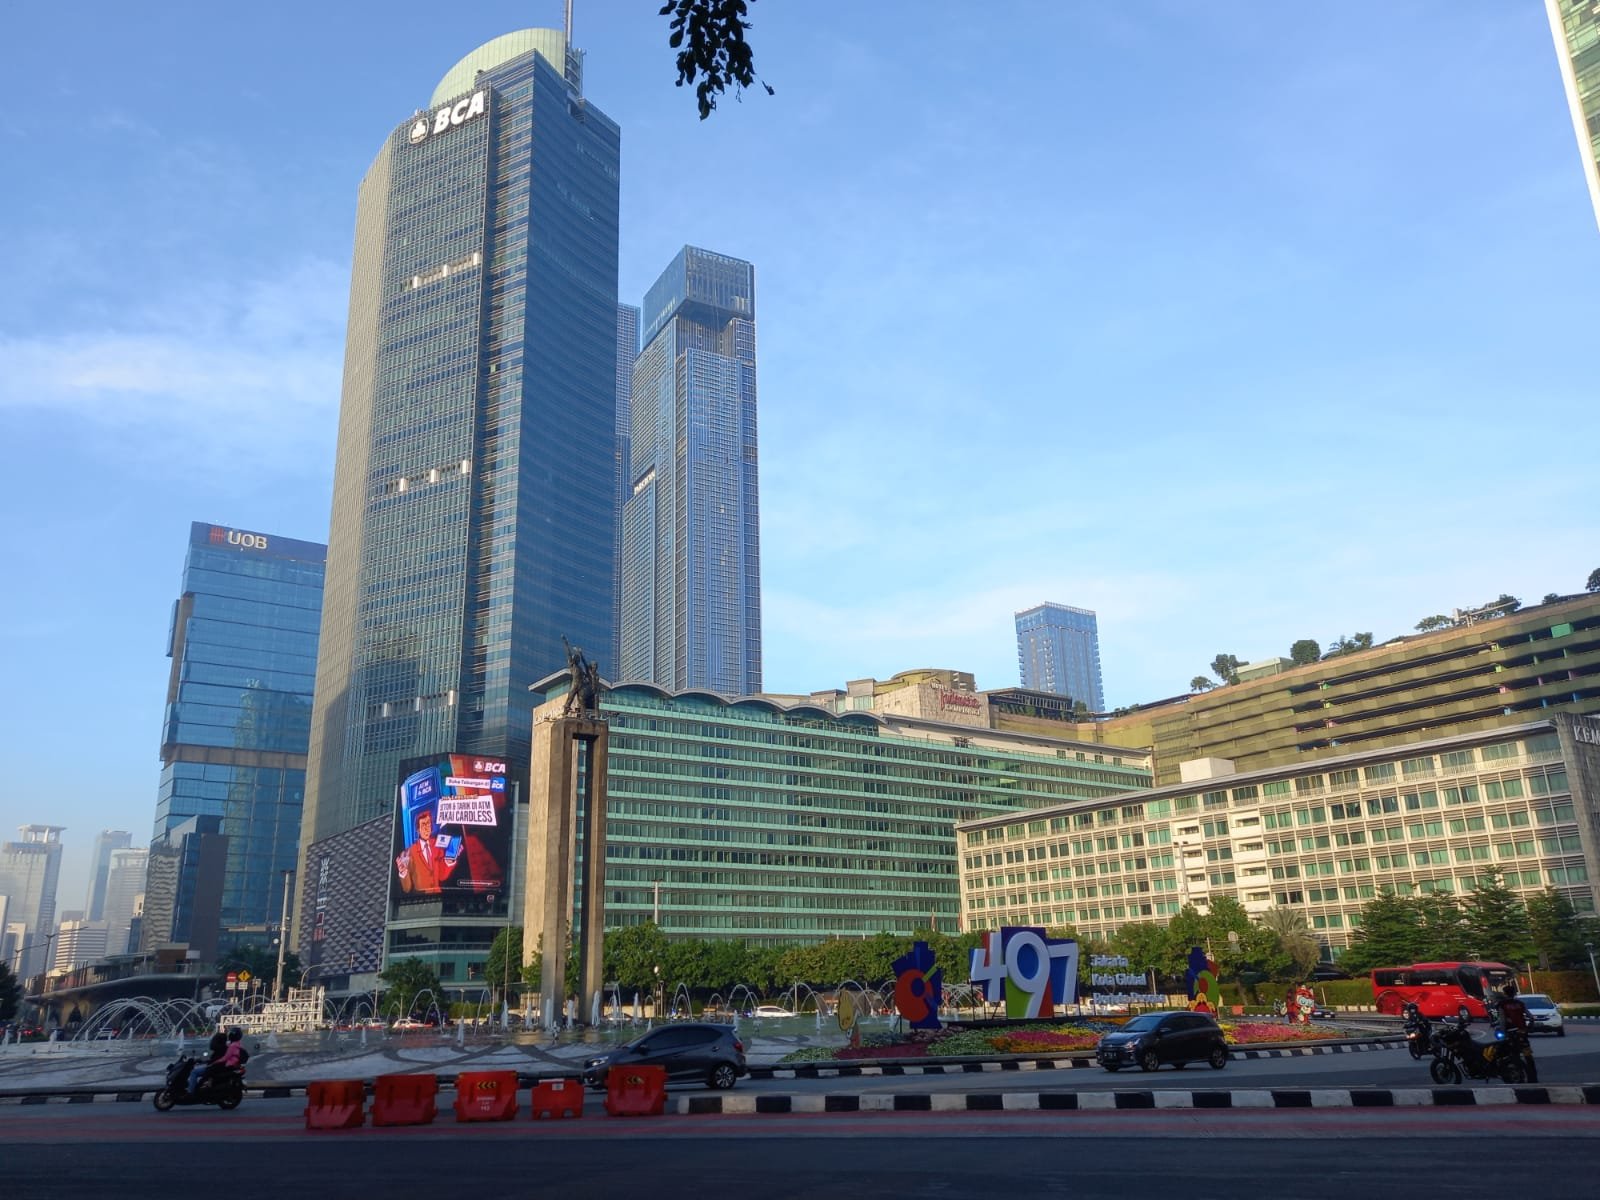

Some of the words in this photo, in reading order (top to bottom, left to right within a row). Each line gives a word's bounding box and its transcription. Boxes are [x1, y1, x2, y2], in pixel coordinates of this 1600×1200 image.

[433, 91, 484, 135] BCA
[228, 531, 267, 549] UOB
[485, 762, 506, 773] BCA
[457, 801, 471, 810] TARIK
[472, 801, 477, 810] DI
[478, 800, 491, 810] ATM
[439, 810, 455, 822] PAKAI
[455, 810, 493, 823] CARDLESS
[1090, 954, 1128, 967] Jakarta
[970, 930, 1079, 1019] 497
[1091, 973, 1115, 986] Kota
[1116, 973, 1147, 986] Global
